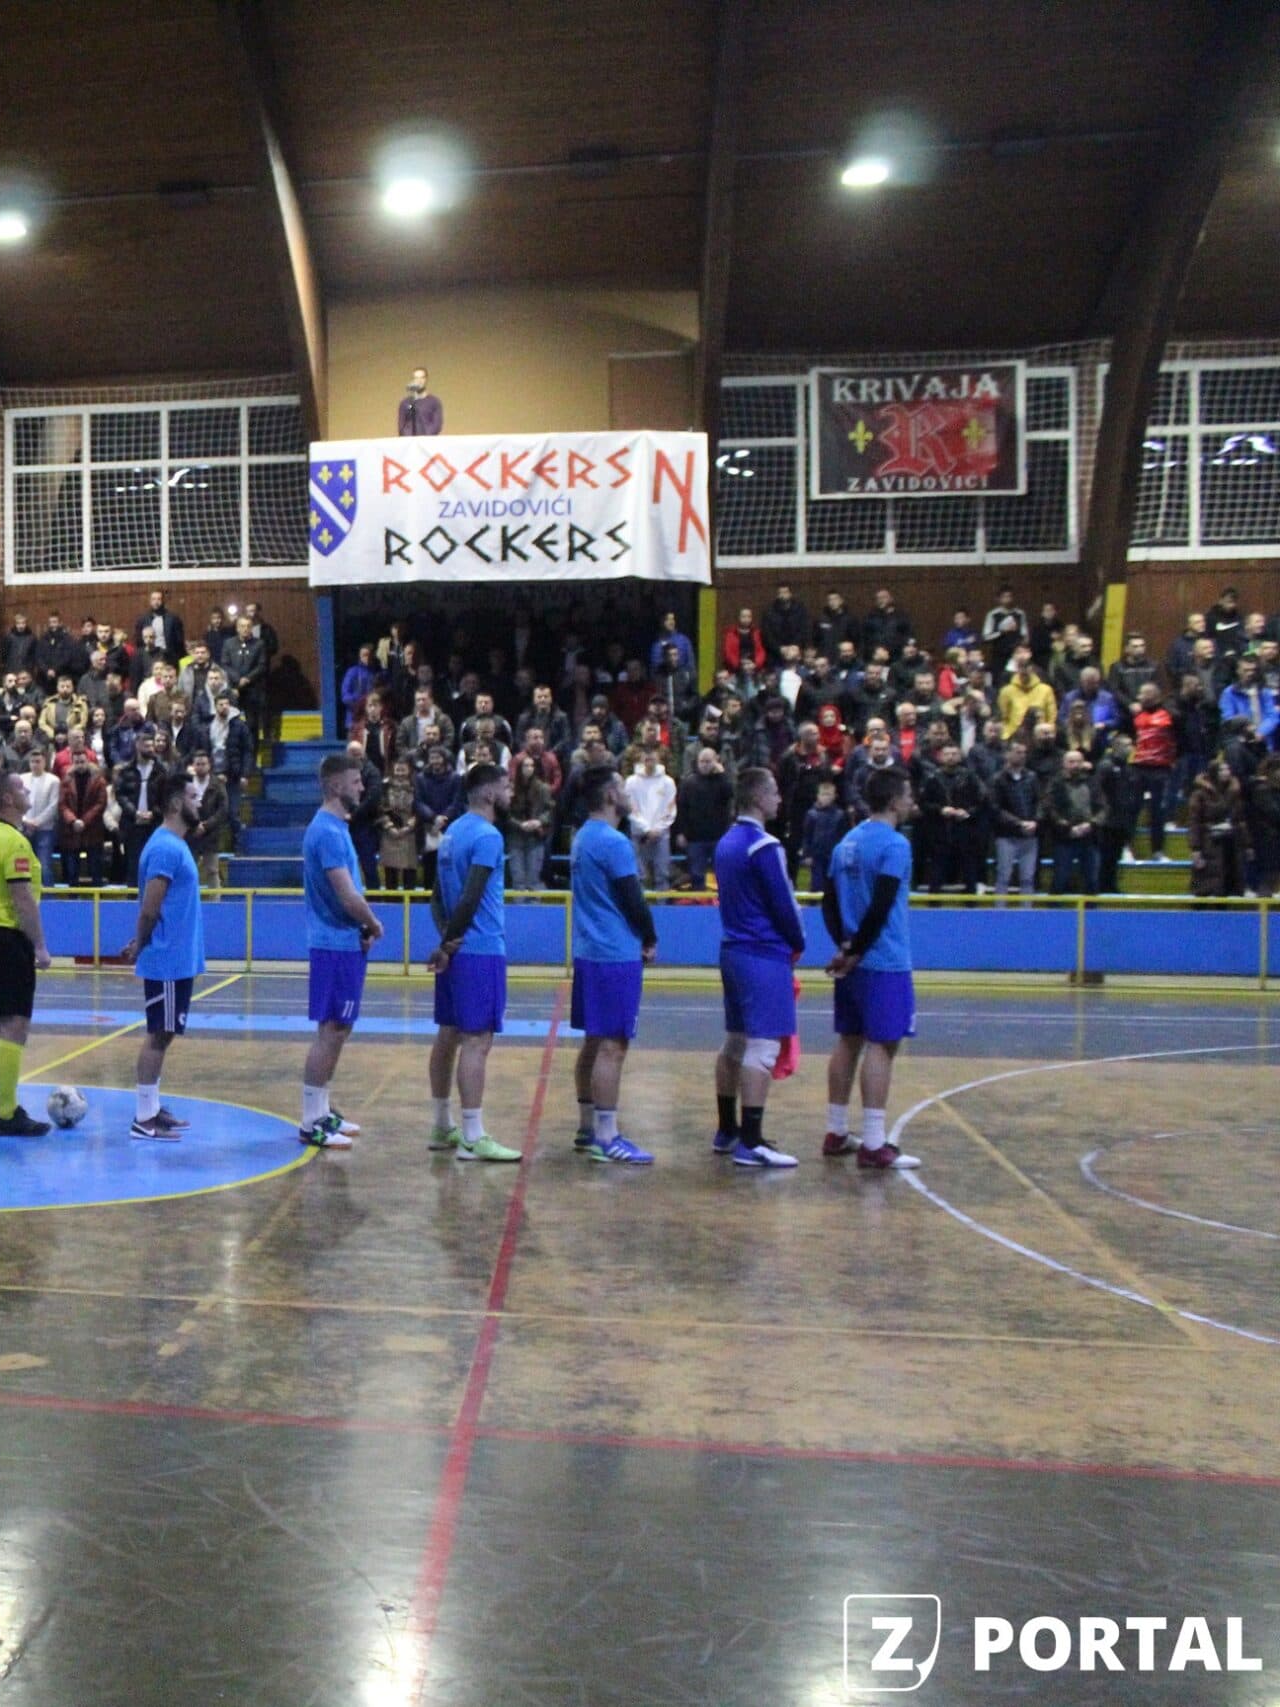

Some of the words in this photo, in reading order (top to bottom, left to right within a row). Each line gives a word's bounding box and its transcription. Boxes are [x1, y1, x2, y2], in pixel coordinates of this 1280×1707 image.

[833, 373, 1000, 403] KRIVAJA
[382, 447, 632, 493] ROCKERS
[439, 494, 572, 519] ZAVIDOVIĆI
[384, 521, 631, 565] ROCKERS
